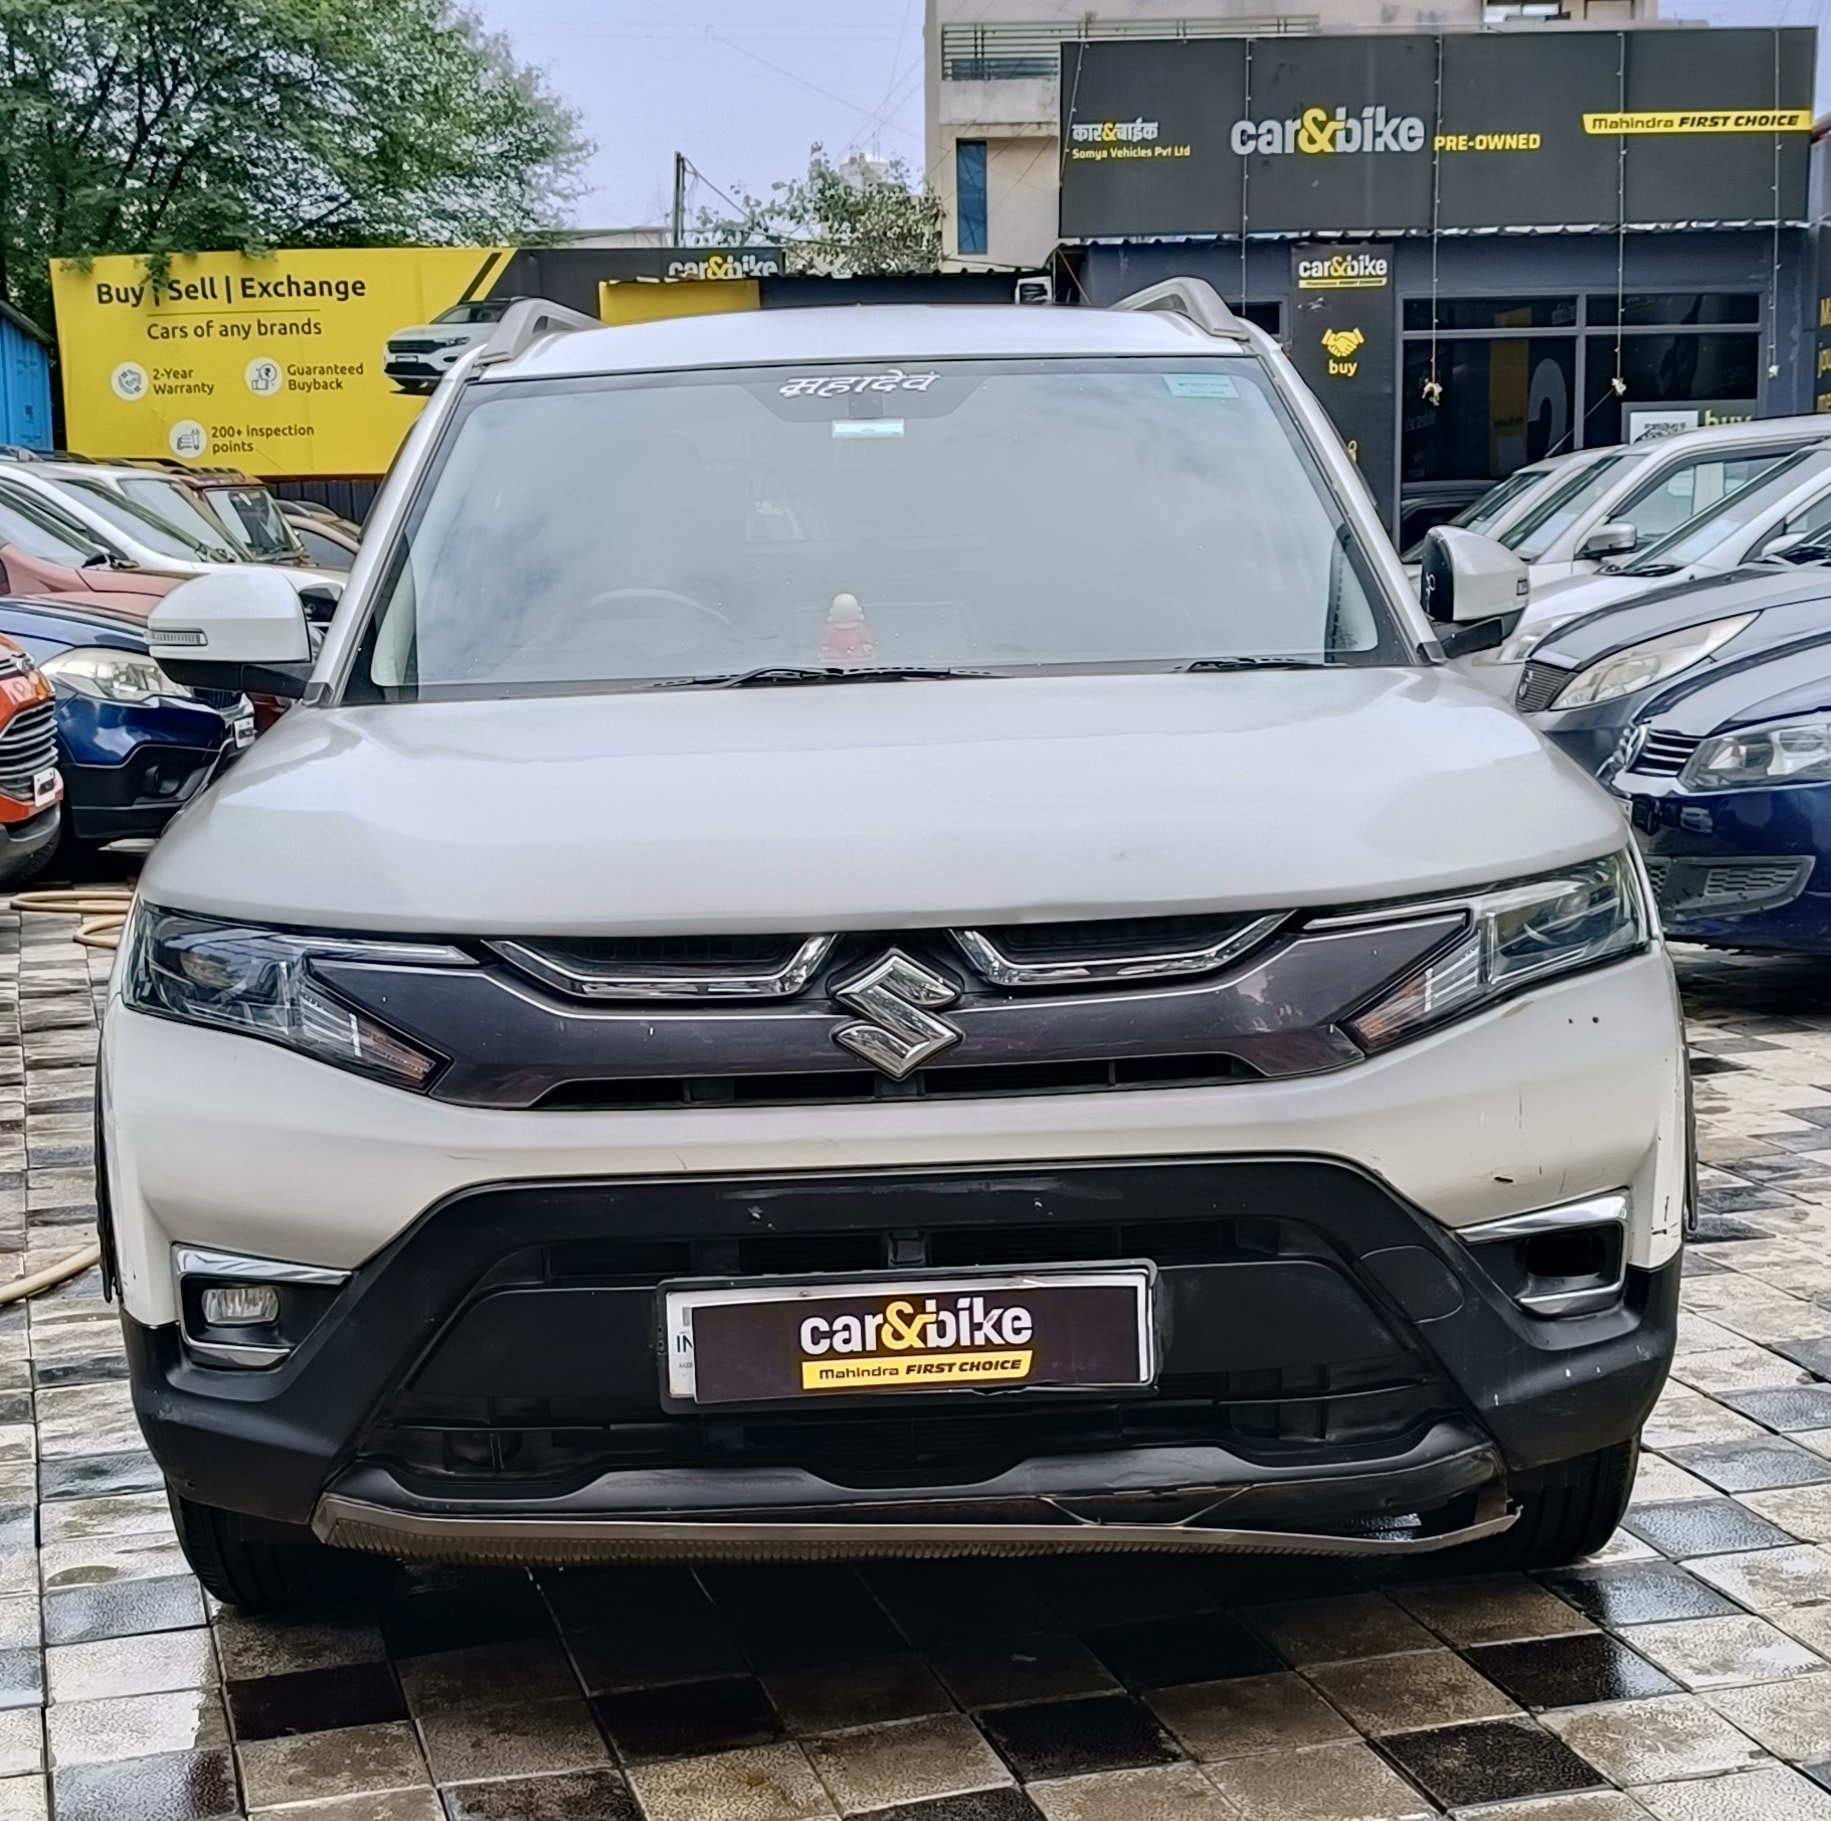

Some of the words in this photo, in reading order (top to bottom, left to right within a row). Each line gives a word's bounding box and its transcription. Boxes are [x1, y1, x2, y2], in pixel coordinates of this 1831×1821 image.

[1592, 117, 1674, 129] Mahindra
[1678, 115, 1731, 128] FIRST
[1734, 114, 1800, 127] CHOICE
[1231, 106, 1425, 155] car&bike
[1434, 134, 1541, 151] PRE-OWNED
[1072, 148, 1107, 160] Somya
[1110, 146, 1151, 158] Vehicles
[1154, 146, 1172, 157] Pvt
[1174, 145, 1191, 156] Ltd
[1299, 254, 1387, 277] car&bike
[96, 283, 145, 308] Buy
[168, 276, 218, 300] Sell
[241, 274, 366, 301] Exchange
[147, 323, 188, 339] Cars
[193, 320, 214, 338] of
[219, 323, 252, 340] any
[257, 318, 322, 336] brands
[153, 368, 194, 380] 2-Year
[287, 363, 364, 376] Guaranteed
[1328, 359, 1358, 376] buy
[153, 382, 215, 396] Warranty
[288, 379, 343, 393] Buyback
[211, 426, 243, 438] 200+
[246, 424, 315, 439] inspection
[212, 441, 254, 454] points
[800, 1296, 1033, 1355] car&bike
[820, 1367, 899, 1380] Mahindra
[906, 1363, 957, 1375] FIRST
[958, 1359, 1022, 1372] CHOICE
